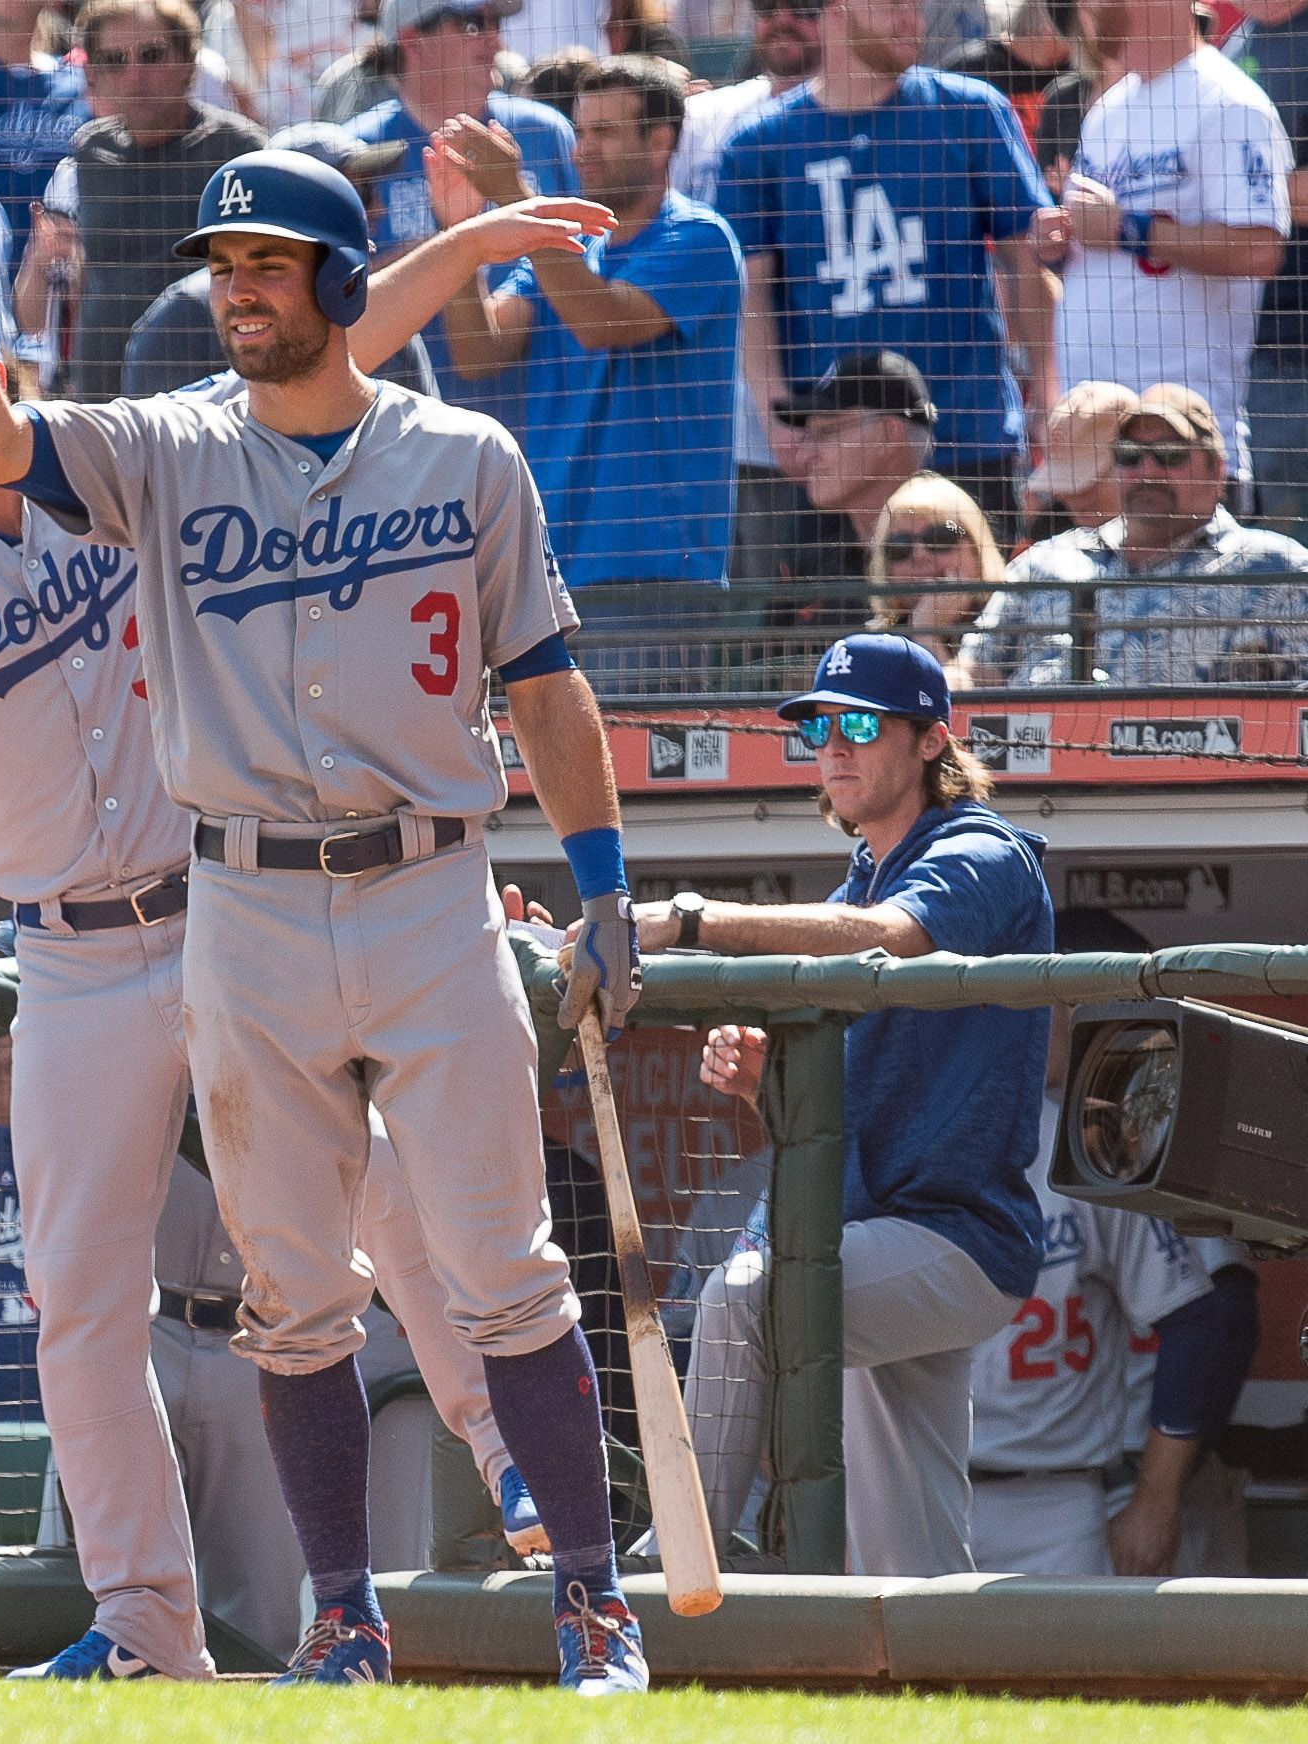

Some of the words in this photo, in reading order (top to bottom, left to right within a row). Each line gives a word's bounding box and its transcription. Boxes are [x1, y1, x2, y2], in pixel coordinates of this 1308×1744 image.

[218, 170, 253, 217] LA
[804, 156, 928, 319] LA
[179, 495, 476, 612] Dodgers
[410, 590, 461, 697] 3
[1236, 1121, 1273, 1139] FUJIFILM
[1009, 1295, 1097, 1382] 25
